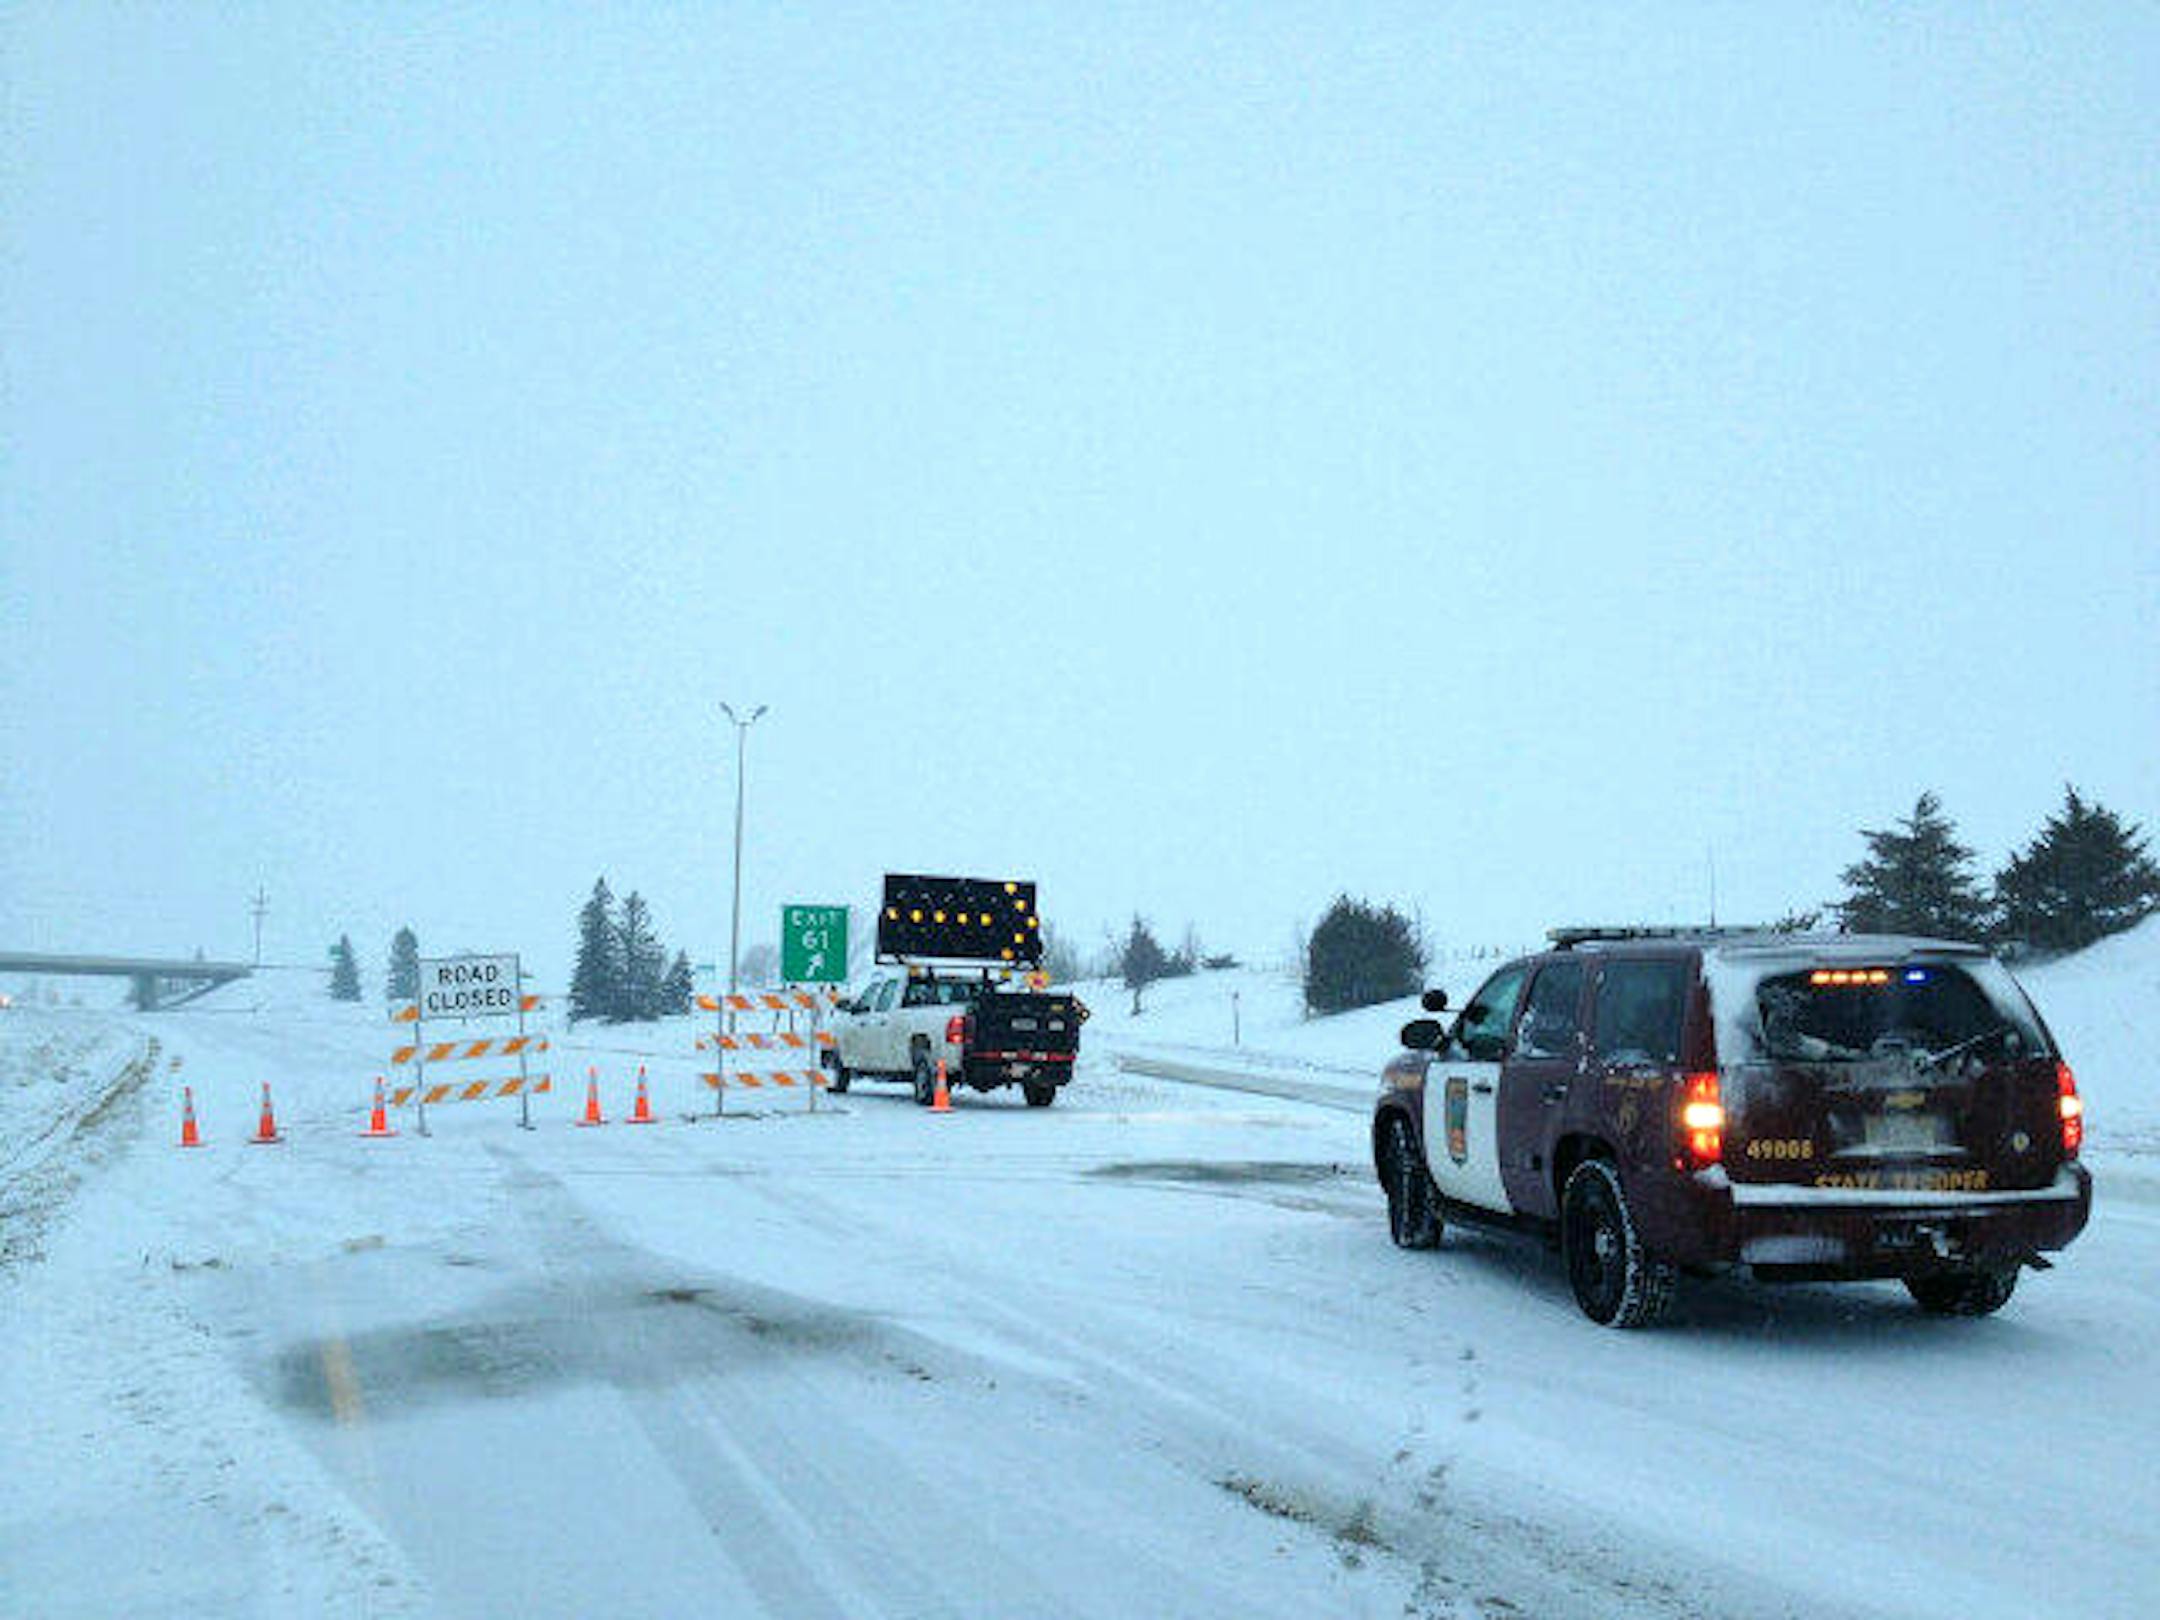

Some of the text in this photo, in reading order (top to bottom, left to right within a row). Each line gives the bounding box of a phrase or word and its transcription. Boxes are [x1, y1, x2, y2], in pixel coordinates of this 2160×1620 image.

[802, 930, 829, 950] 61
[438, 964, 498, 984] ROAD
[428, 988, 511, 1012] CLOSED
